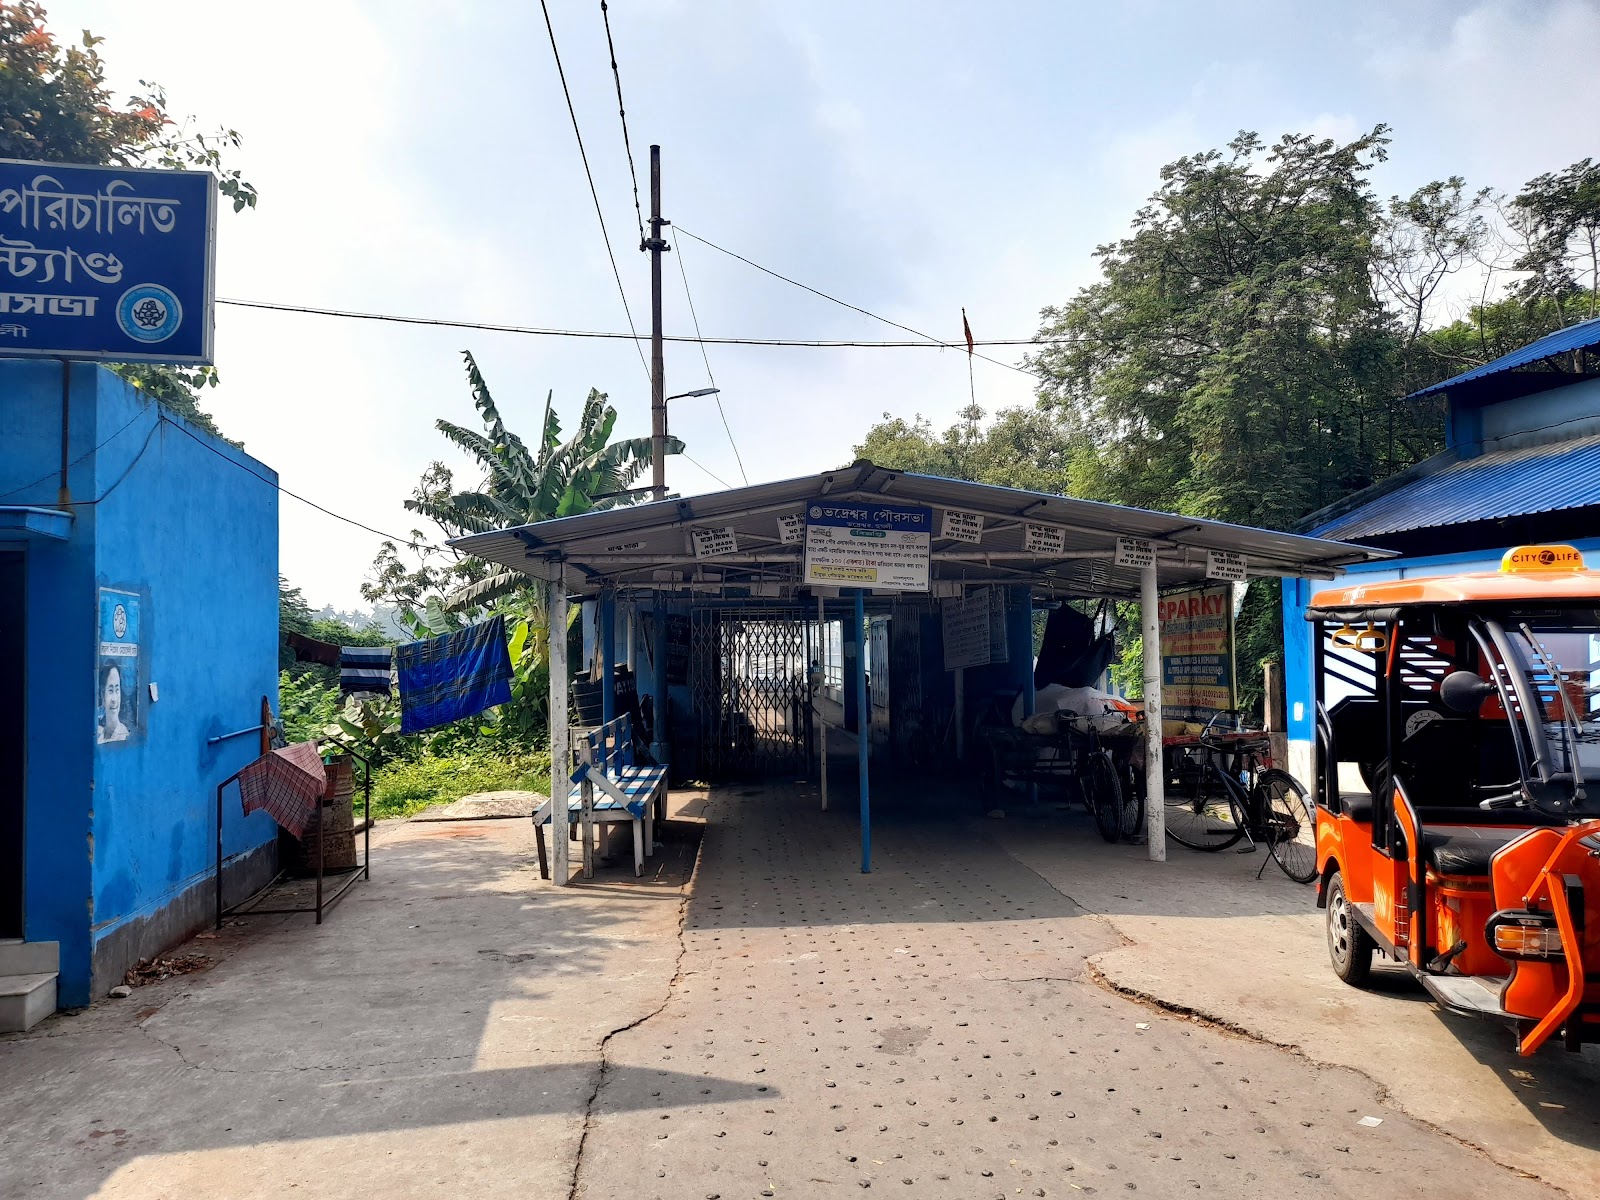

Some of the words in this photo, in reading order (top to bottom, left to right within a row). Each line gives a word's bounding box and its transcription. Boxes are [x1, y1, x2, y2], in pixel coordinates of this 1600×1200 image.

[0, 175, 182, 235] পরিচালিত
[822, 508, 868, 521] ভদ্রেশ্বর
[873, 508, 924, 524] পৌরসভা
[1512, 554, 1537, 562] CITY
